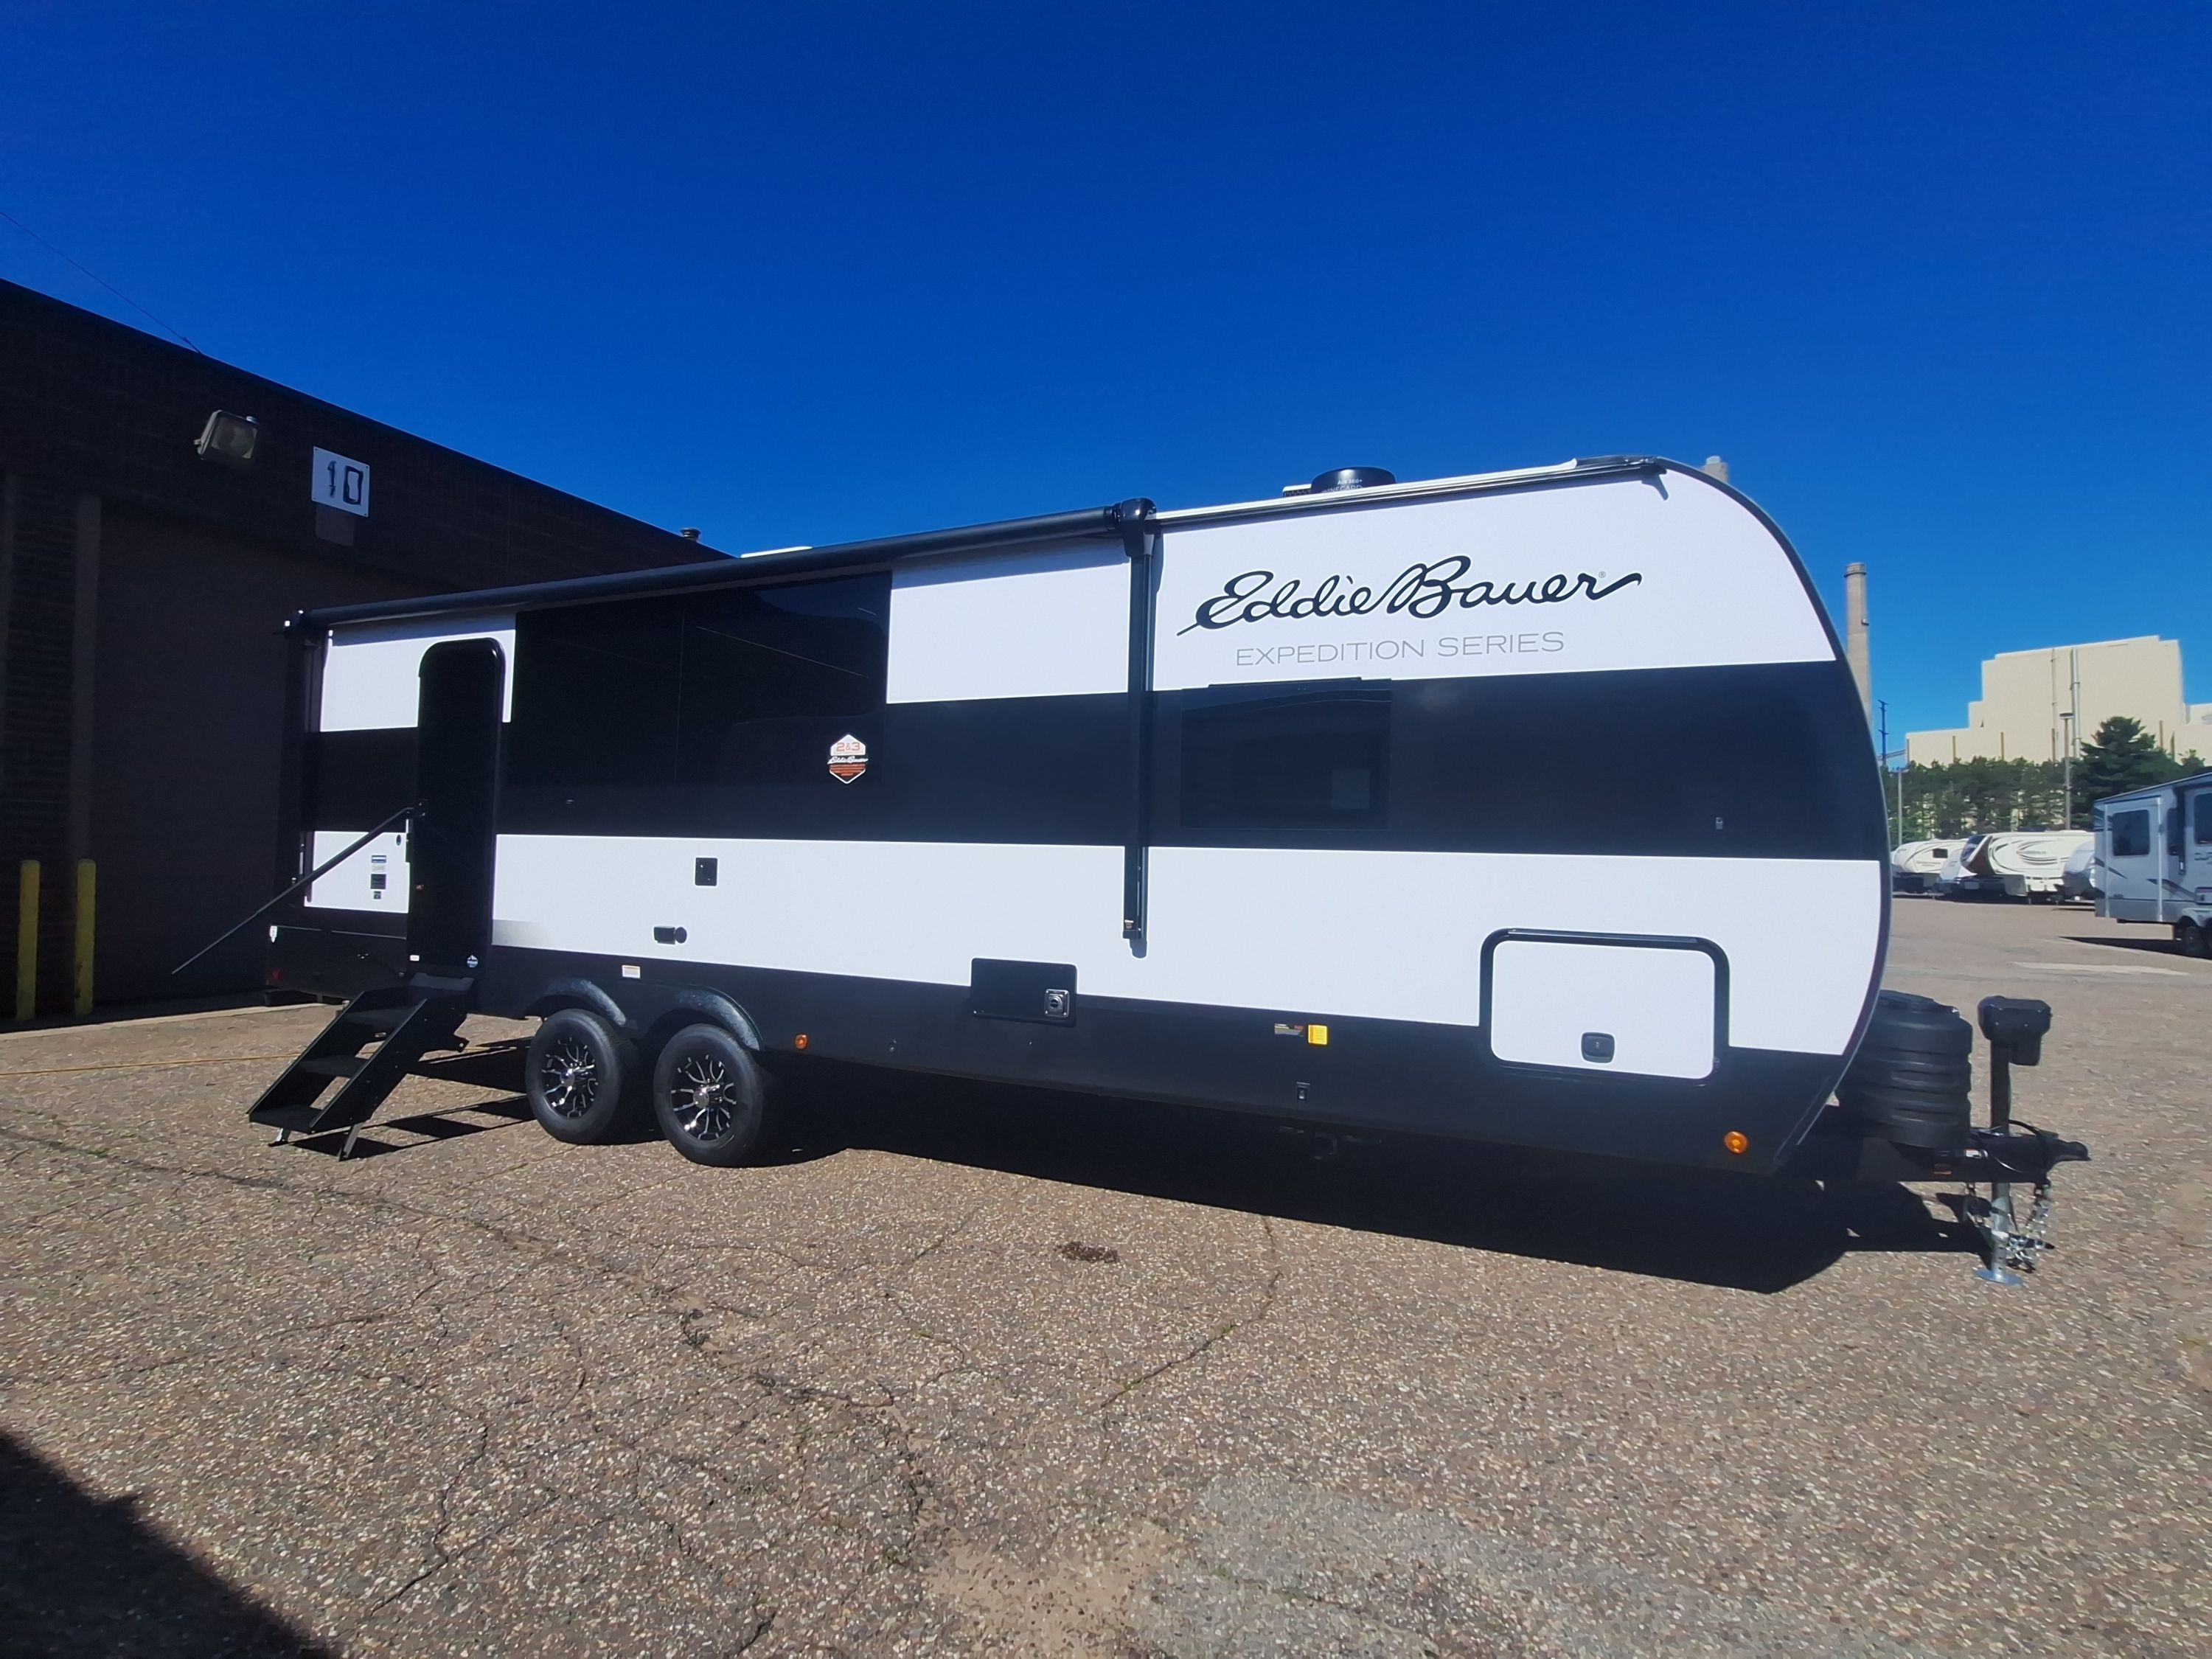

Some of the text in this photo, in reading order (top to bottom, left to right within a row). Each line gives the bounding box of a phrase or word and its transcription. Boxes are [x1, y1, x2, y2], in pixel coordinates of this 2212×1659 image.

[327, 461, 364, 506] 10
[1177, 554, 1643, 636] Eddie Bauer
[1236, 631, 1565, 667] EXPEDITION SERIES
